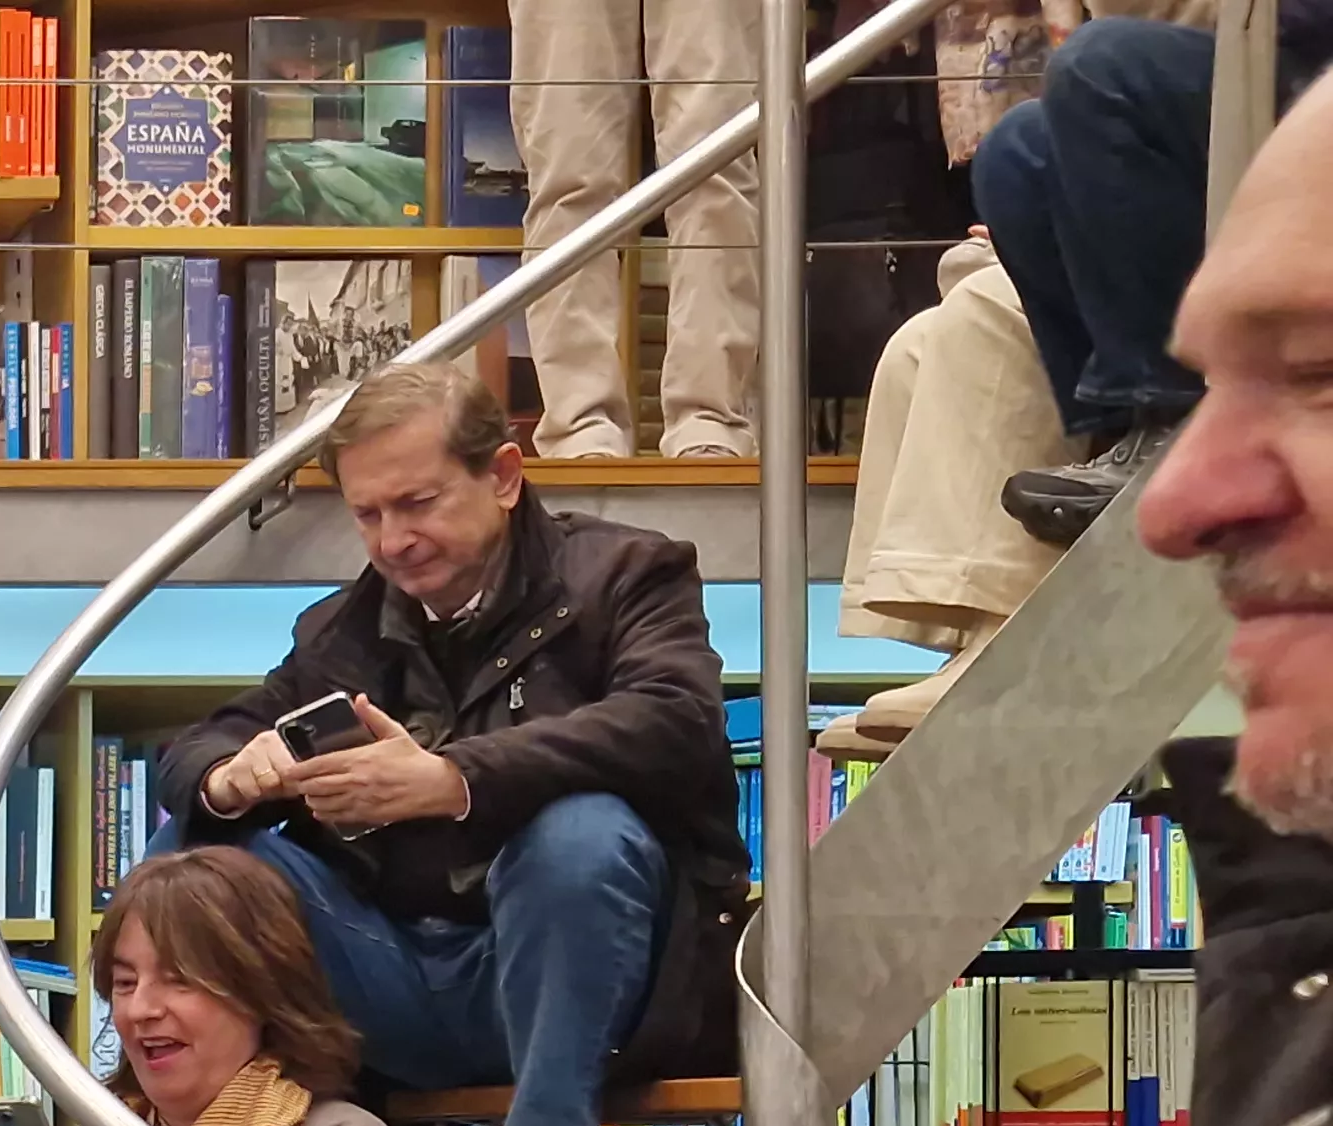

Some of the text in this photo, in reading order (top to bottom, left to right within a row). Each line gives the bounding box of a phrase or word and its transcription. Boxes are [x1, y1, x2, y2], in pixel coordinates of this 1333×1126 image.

[126, 119, 207, 144] ESPAÑA
[126, 144, 207, 157] MONUMENTAL
[258, 335, 271, 392] OCULTA
[255, 345, 271, 449] ESPAÑA
